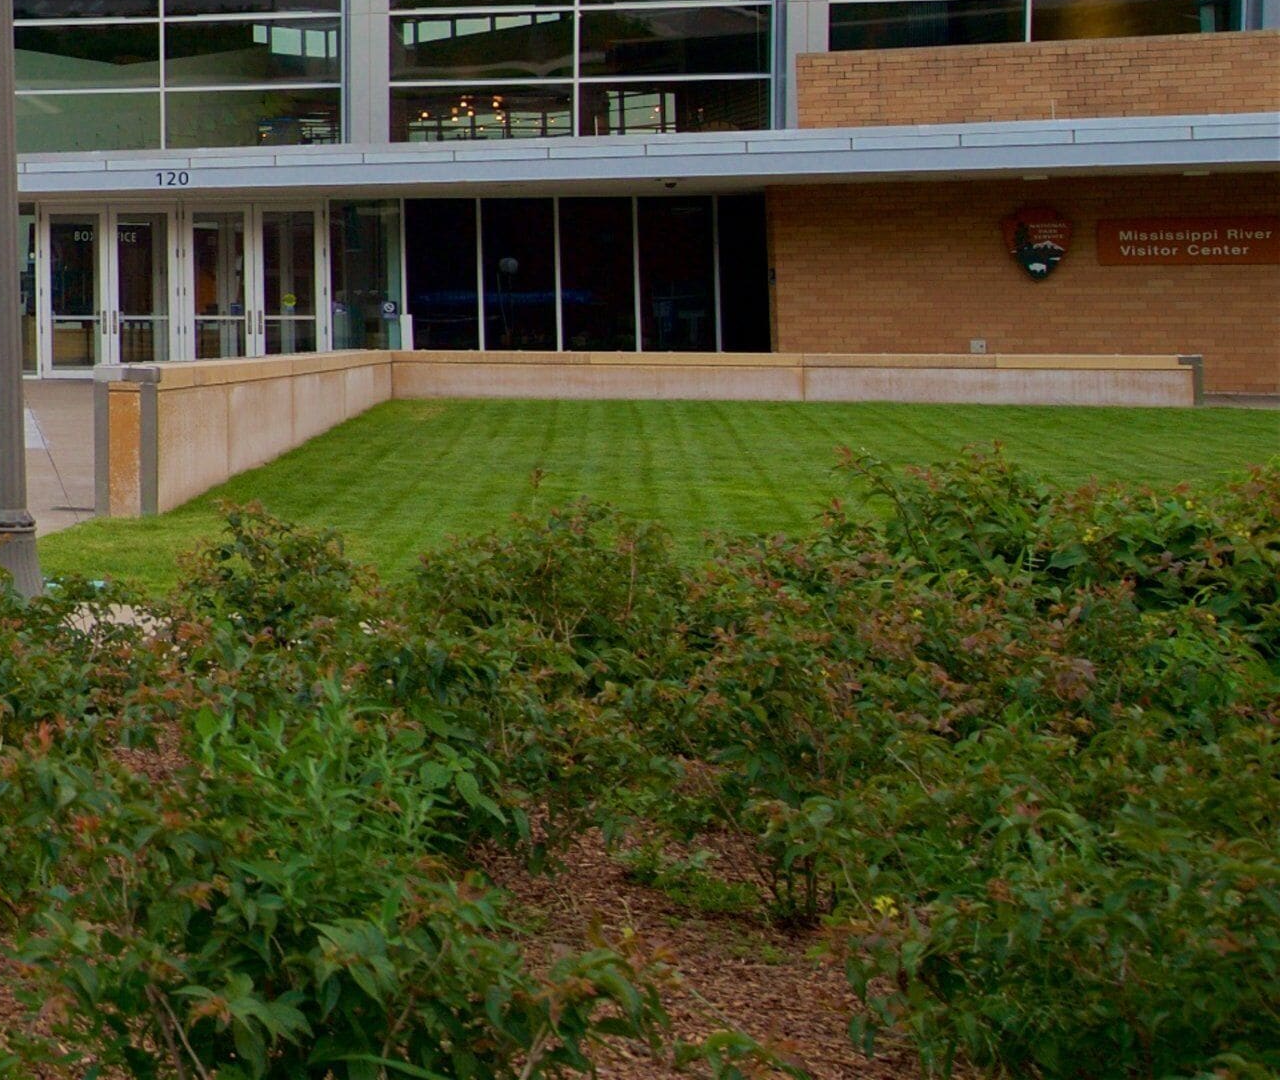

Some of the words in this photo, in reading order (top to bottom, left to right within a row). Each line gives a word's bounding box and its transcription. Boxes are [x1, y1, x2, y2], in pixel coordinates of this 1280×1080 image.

[156, 171, 189, 186] 120
[1119, 229, 1219, 242] Mississippi
[1227, 228, 1272, 240] River
[1120, 244, 1178, 256] Visitor
[1187, 243, 1249, 256] Center
